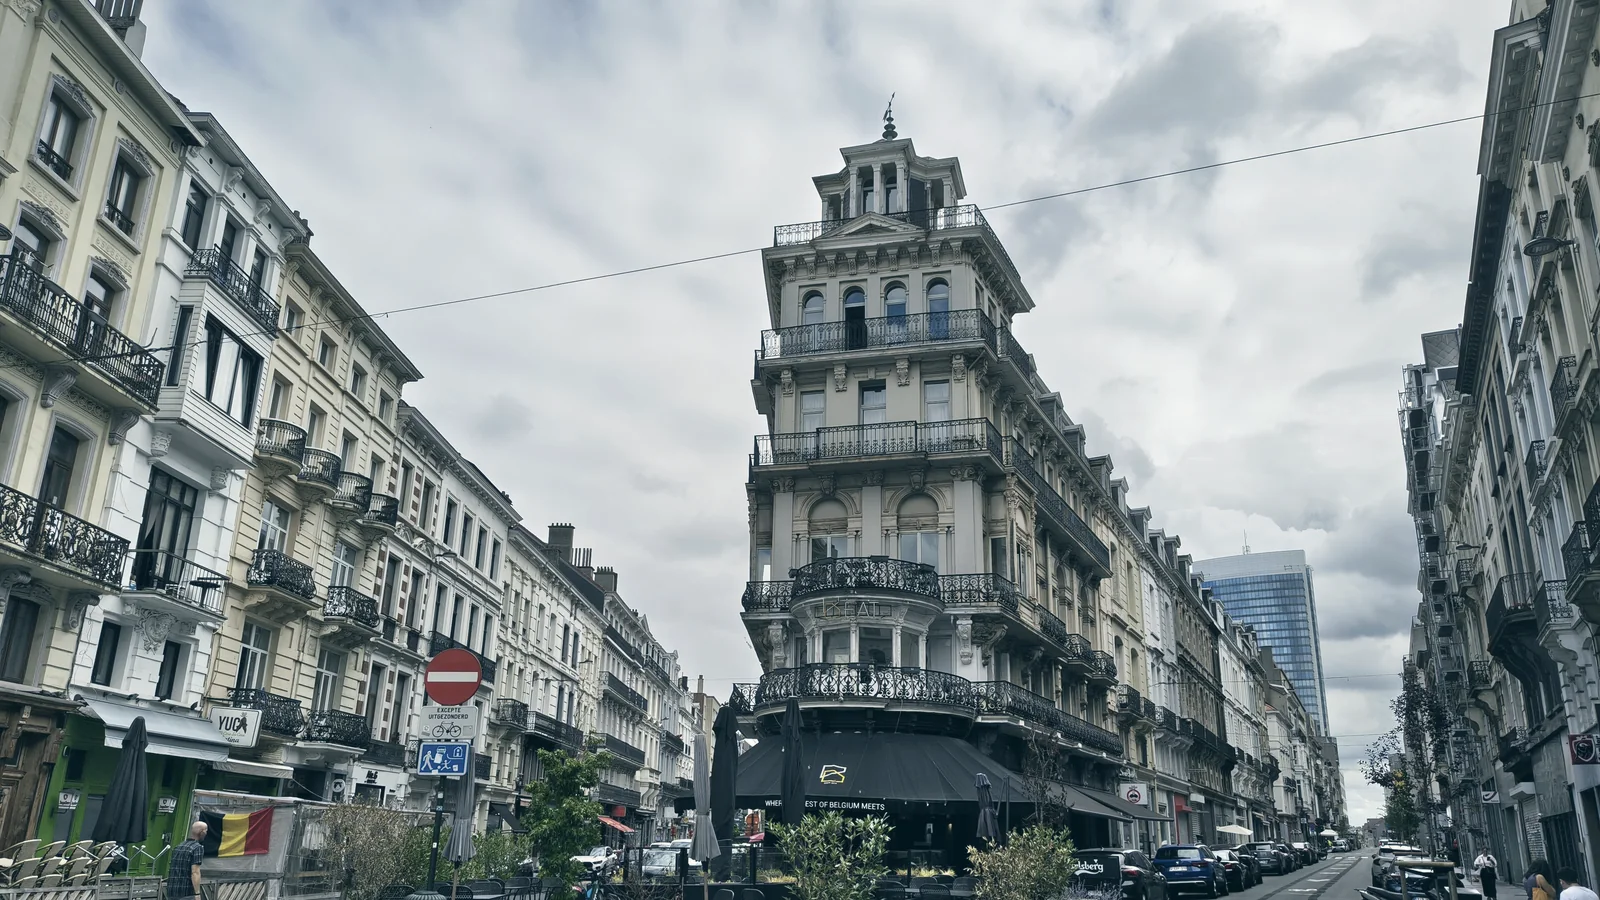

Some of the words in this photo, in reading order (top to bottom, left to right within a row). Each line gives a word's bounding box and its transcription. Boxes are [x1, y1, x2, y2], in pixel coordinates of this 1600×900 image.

[805, 800, 818, 808] EST
[829, 801, 860, 809] BELGIUM
[861, 802, 886, 811] MEETS
